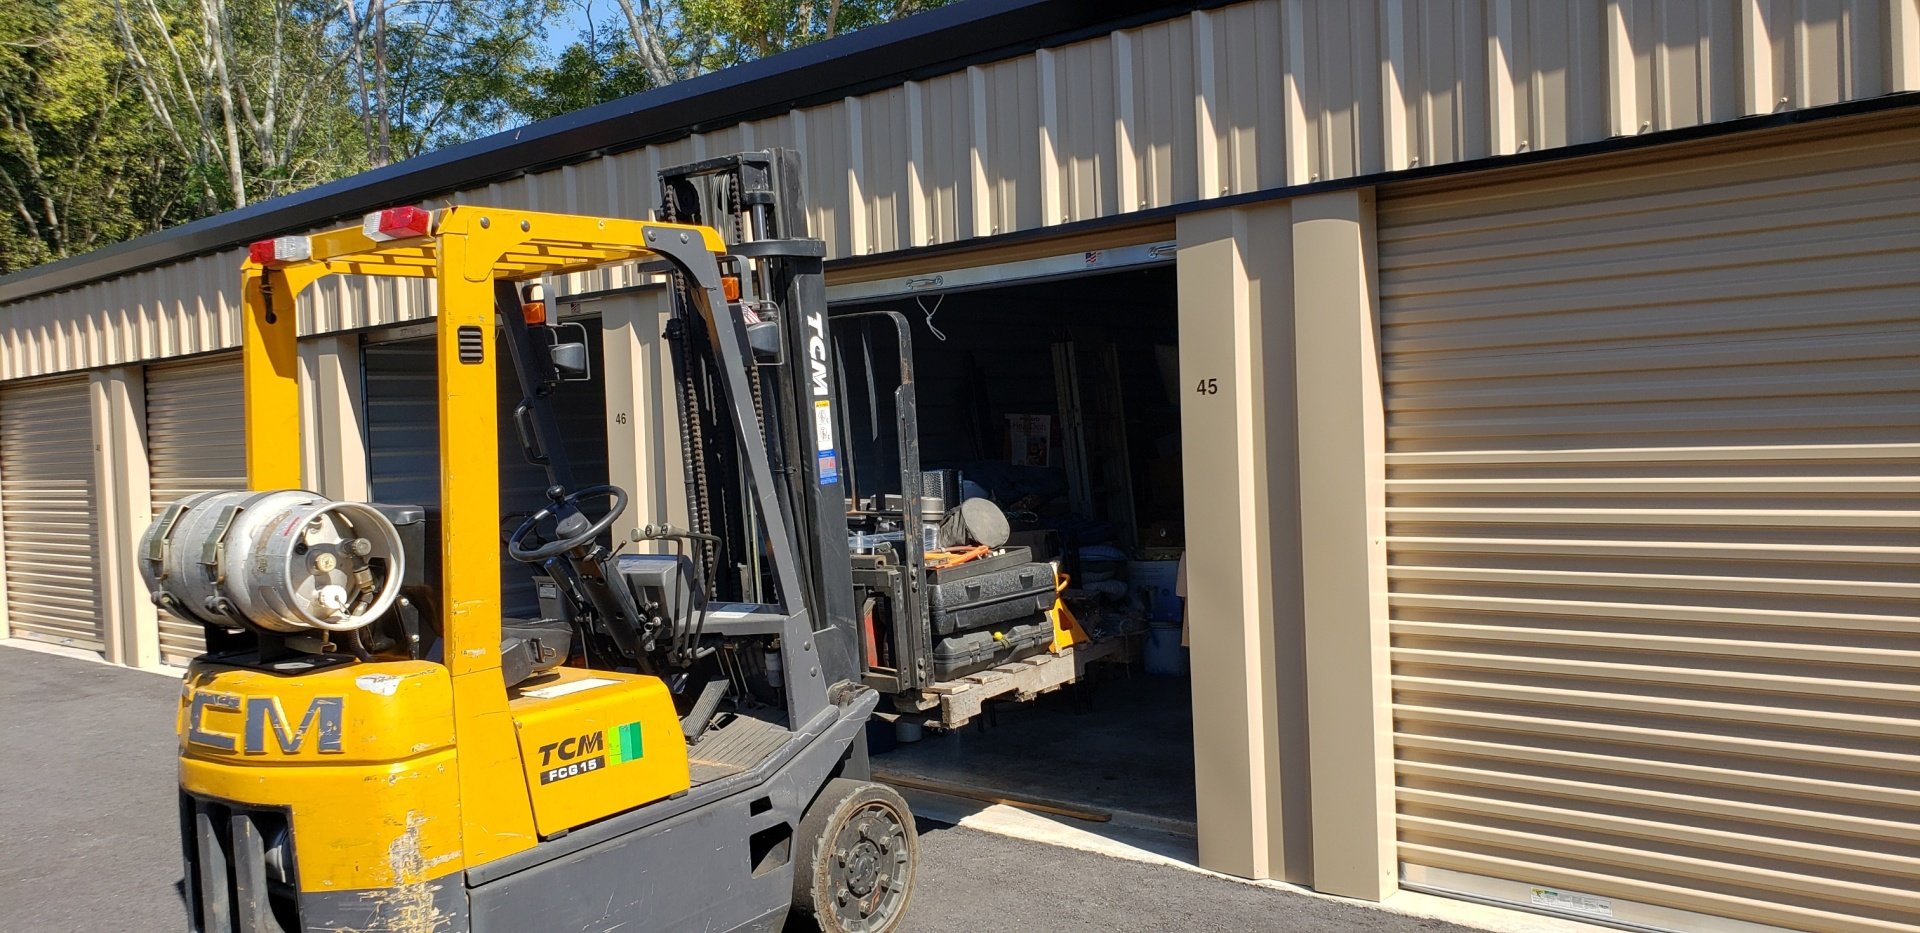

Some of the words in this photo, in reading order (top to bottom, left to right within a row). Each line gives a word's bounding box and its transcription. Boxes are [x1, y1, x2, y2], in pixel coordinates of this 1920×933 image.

[807, 312, 828, 396] TCM
[1196, 378, 1218, 395] 45
[615, 412, 627, 425] 46
[182, 689, 344, 753] CM
[538, 731, 604, 767] TCM
